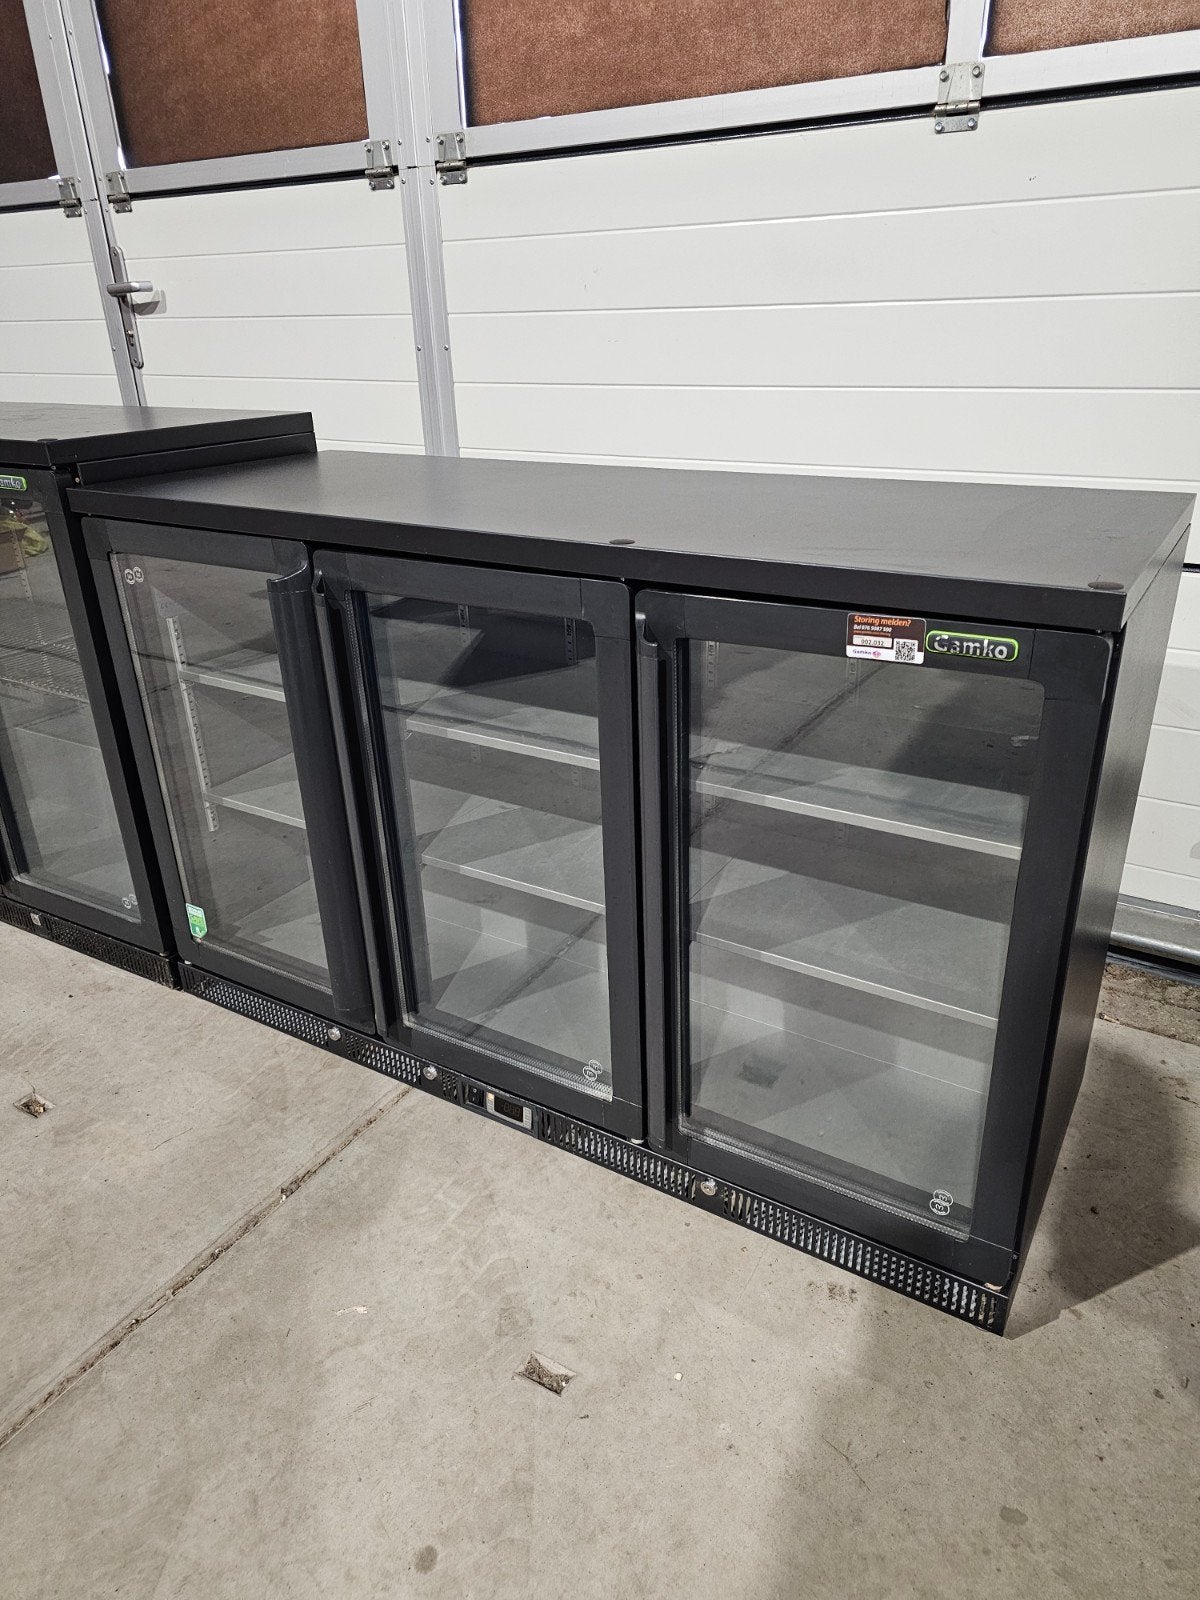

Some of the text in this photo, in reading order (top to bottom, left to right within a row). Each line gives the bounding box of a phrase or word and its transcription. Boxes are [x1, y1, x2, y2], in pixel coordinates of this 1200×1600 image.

[0, 477, 20, 489] amko
[854, 616, 912, 626] Storing melden?
[933, 634, 1008, 659] Gamko
